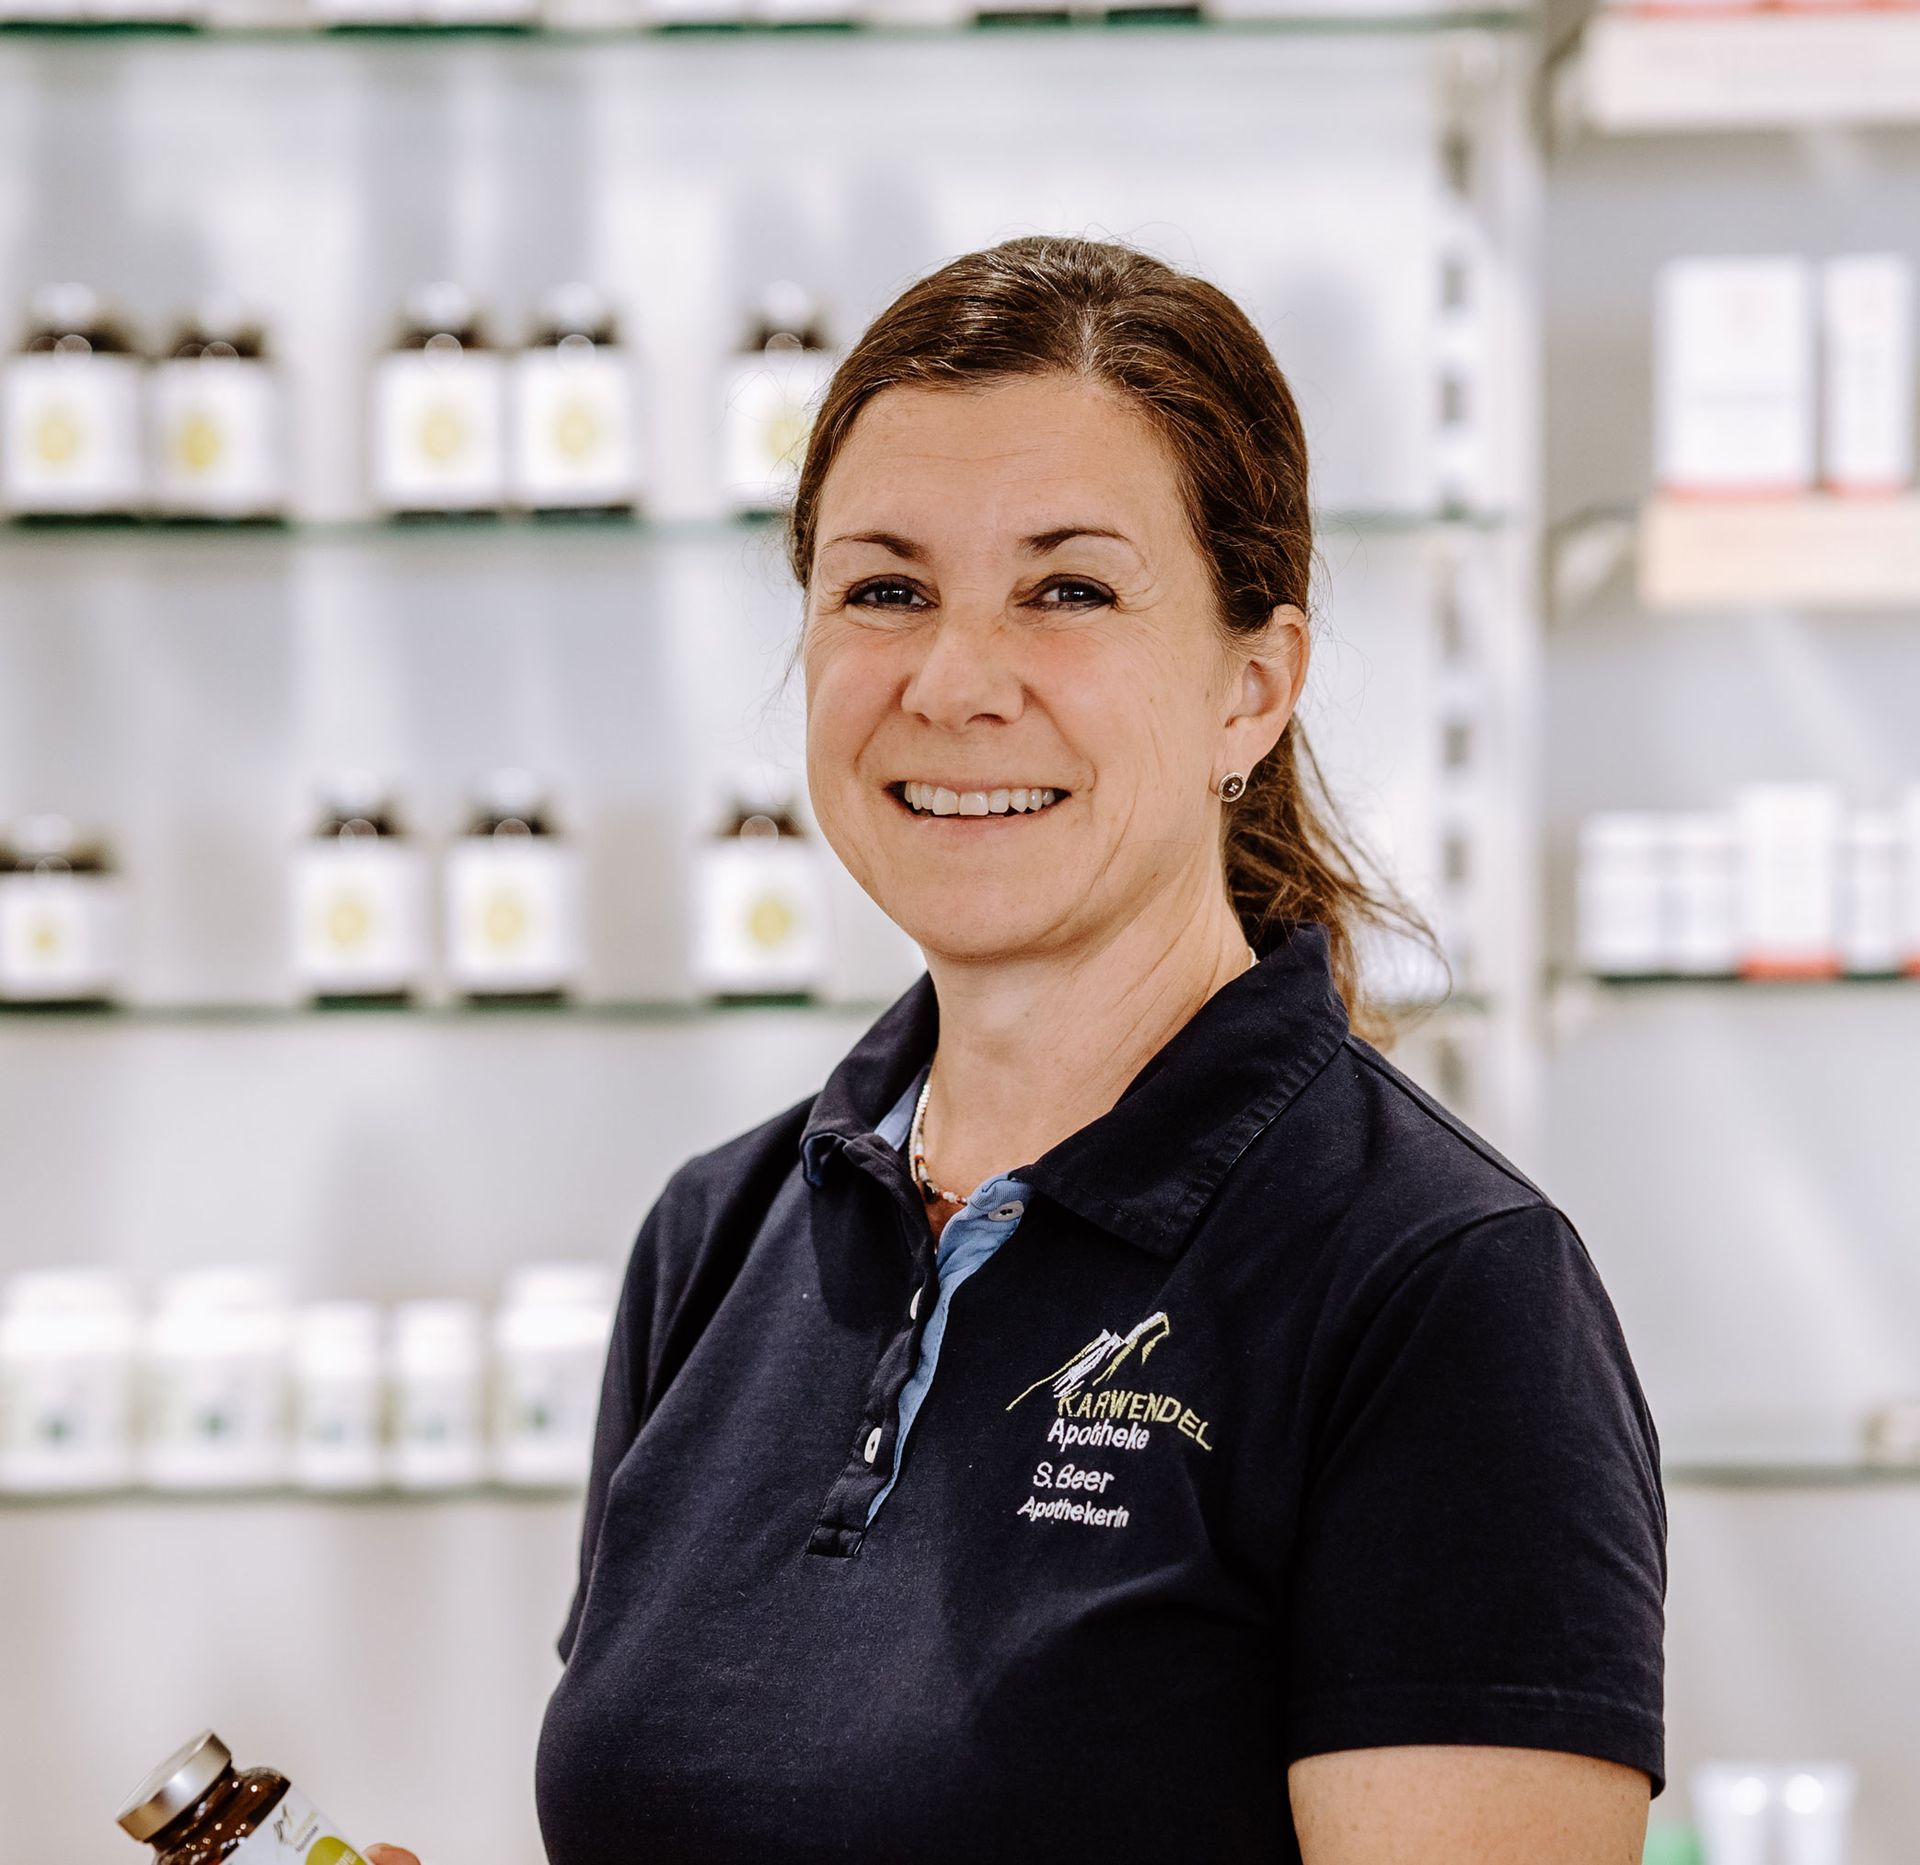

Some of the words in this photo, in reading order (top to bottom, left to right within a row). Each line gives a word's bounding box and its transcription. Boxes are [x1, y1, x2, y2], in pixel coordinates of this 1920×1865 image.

[1047, 1418, 1150, 1452] Apotheke
[1057, 1389, 1213, 1451] KARWENDEL
[1017, 1495, 1130, 1528] Apothekerin
